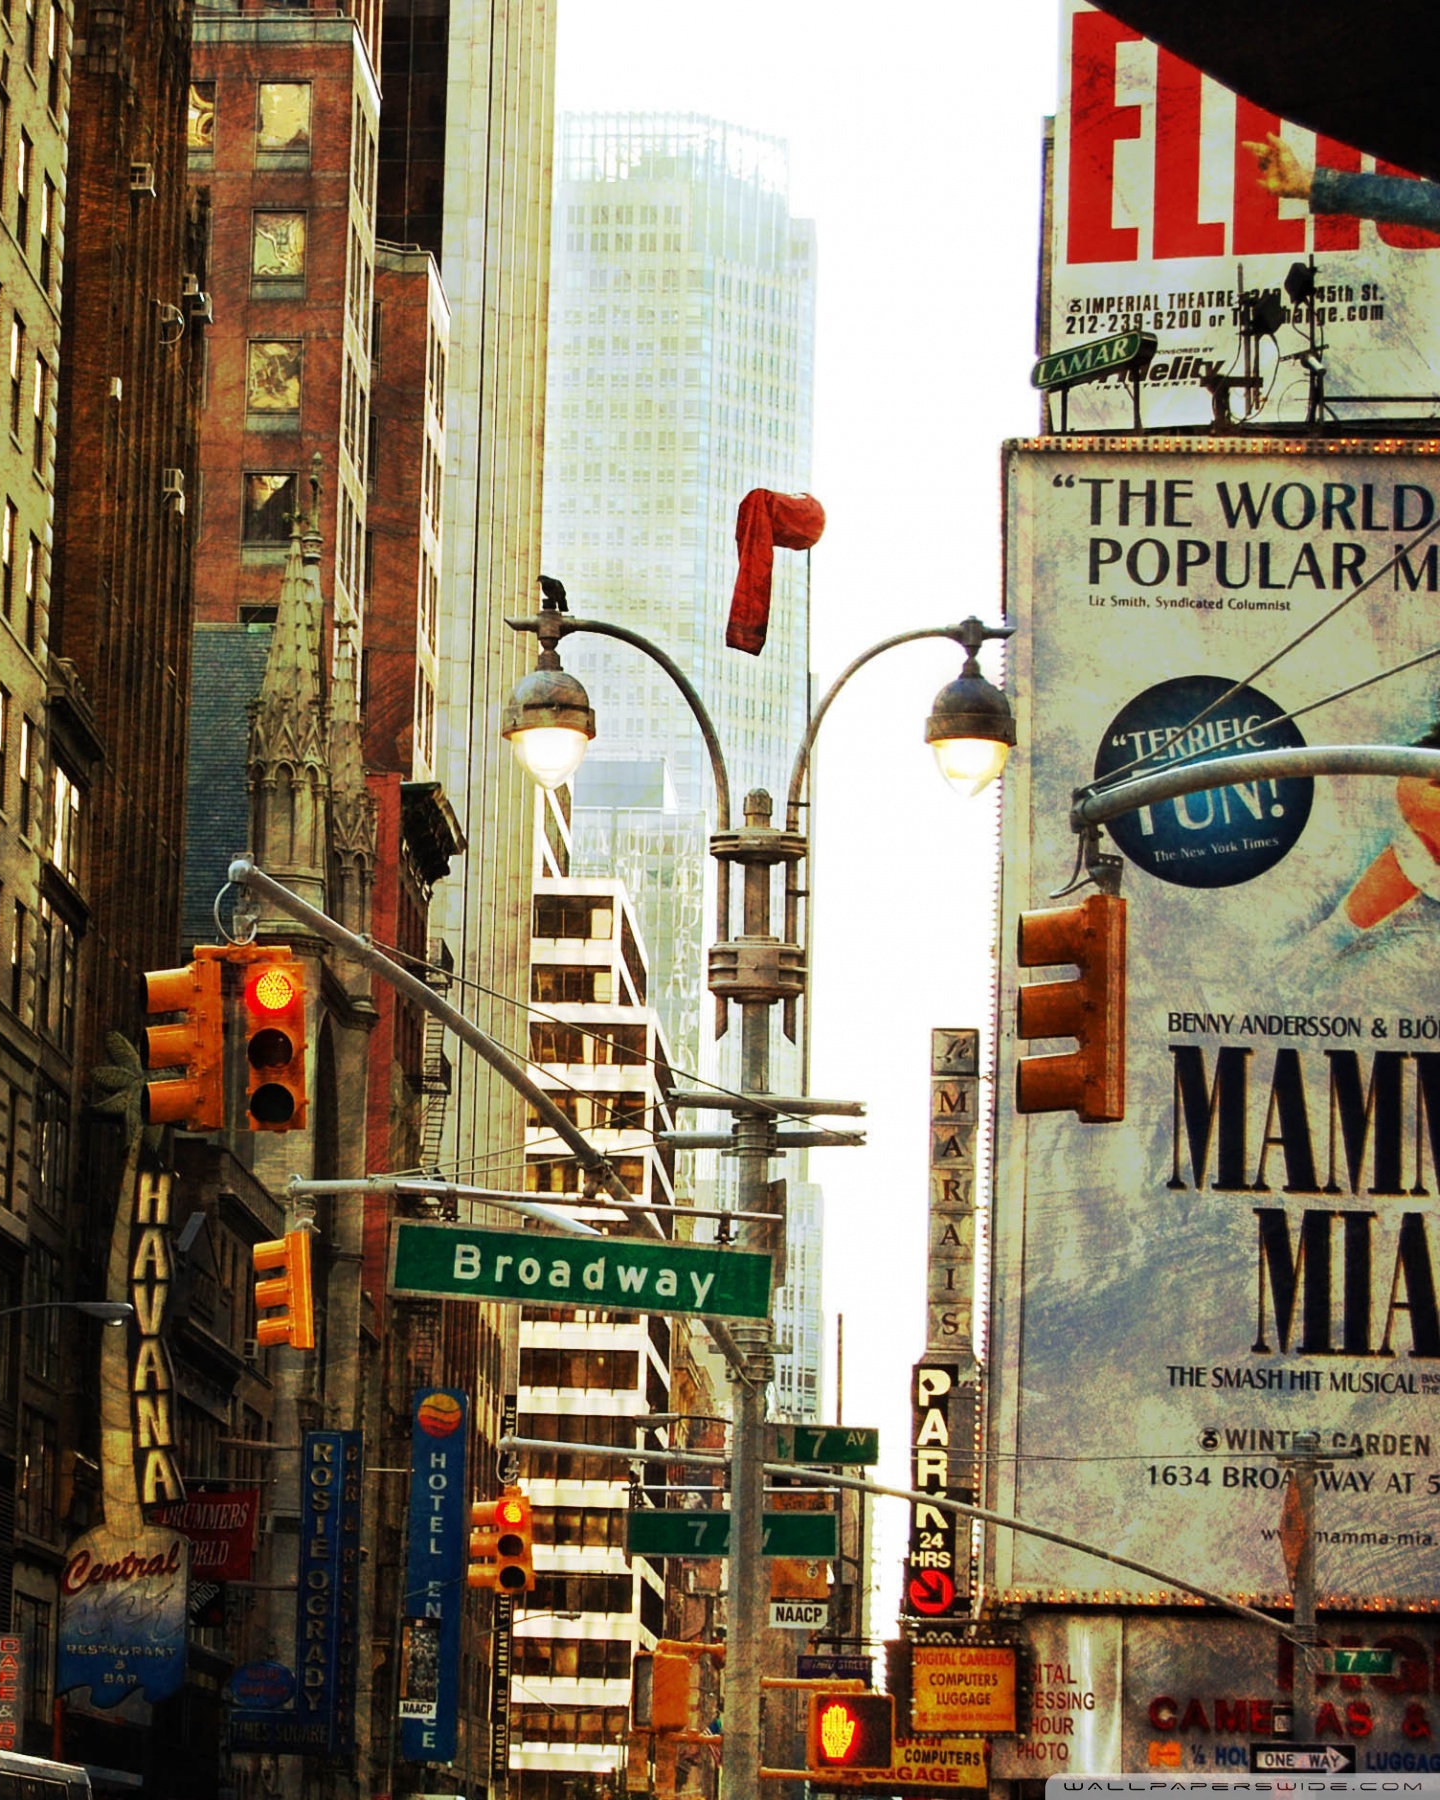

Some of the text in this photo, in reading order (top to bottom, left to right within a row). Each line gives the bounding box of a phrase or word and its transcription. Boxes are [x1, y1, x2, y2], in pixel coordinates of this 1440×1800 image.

[1086, 295, 1160, 315] IMPERIAL
[1361, 283, 1385, 301] St.
[1066, 310, 1201, 335] 212-239-6200
[1209, 314, 1225, 328] or
[1038, 338, 1129, 384] LAMAR
[1216, 481, 1435, 532] WORLD
[1088, 537, 1365, 591] POPULAR
[1087, 594, 1106, 607] Liz
[1155, 596, 1223, 611] Syndicated
[1227, 598, 1291, 611] Columnist
[1154, 836, 1280, 863] The New York Times
[1167, 1012, 1234, 1034] BENNY
[1239, 1014, 1361, 1038] ANDERSSON
[1370, 1018, 1388, 1039] &
[938, 1090, 969, 1336] MARAIS
[453, 1243, 716, 1308] Broadway
[1251, 1207, 1440, 1357] MIA
[132, 1170, 181, 1504] HAVANA
[1166, 1365, 1207, 1388] THE
[1211, 1367, 1283, 1391] SMASH
[1289, 1370, 1324, 1391] HIT
[1329, 1371, 1419, 1395] MUSICAL
[807, 1430, 866, 1459] 7 AV
[916, 1369, 952, 1528] PARK
[344, 1443, 359, 1501] BAR
[1148, 1465, 1211, 1487] 1634
[1222, 1466, 1375, 1493] BROAWAY
[1385, 1472, 1416, 1494] AT
[310, 1442, 334, 1560] ROSIE
[427, 1452, 448, 1555] HOTEL
[162, 1502, 250, 1531] DRUMMERS
[687, 1520, 708, 1547] 7
[919, 1532, 944, 1549] 24
[62, 1540, 181, 1596] Central
[911, 1551, 952, 1568] HRS
[775, 1606, 823, 1623] NAACP
[114, 1659, 126, 1670] &
[497, 1628, 509, 1677] MIRIAM
[915, 1652, 1012, 1666] DIGITAL CAMERAS
[1343, 1652, 1385, 1671] 7 AV
[103, 1673, 138, 1685] BAR
[929, 1673, 999, 1687] COMPUTERS
[402, 1702, 433, 1715] NAACP
[495, 1688, 507, 1713] AND
[936, 1692, 991, 1705] LUGGAGE
[1148, 1696, 1374, 1738] CAMEAS
[1401, 1702, 1432, 1740] &
[494, 1719, 506, 1771] HAROLD
[904, 1748, 981, 1766] COMPUTERS
[1016, 1742, 1070, 1761] PHOTO
[1264, 1753, 1340, 1768] ONE WAY
